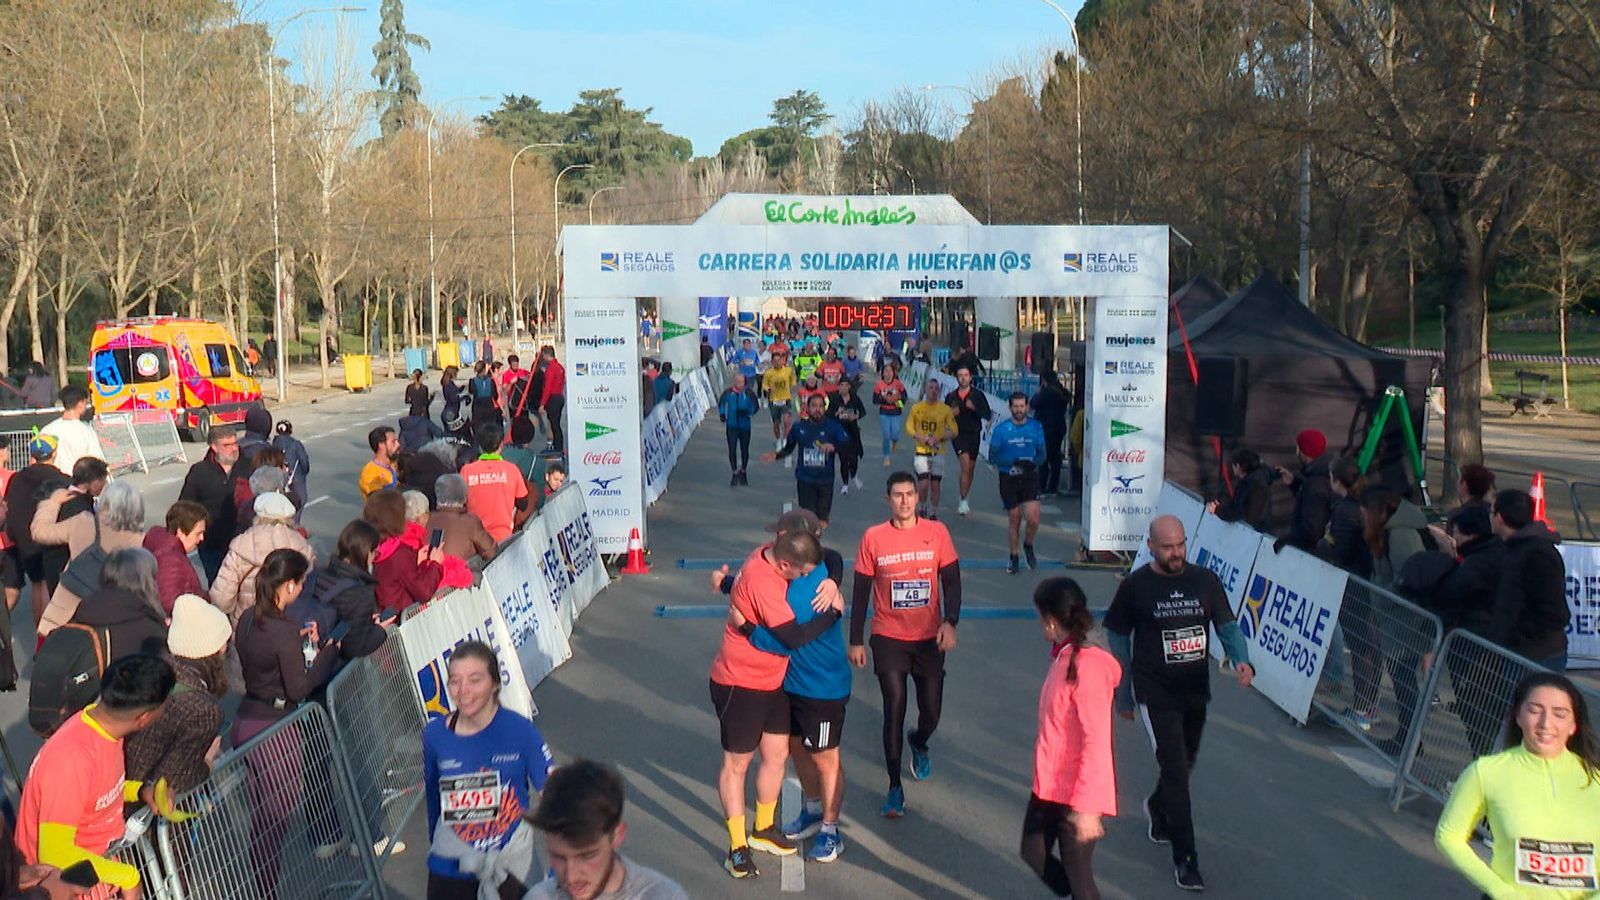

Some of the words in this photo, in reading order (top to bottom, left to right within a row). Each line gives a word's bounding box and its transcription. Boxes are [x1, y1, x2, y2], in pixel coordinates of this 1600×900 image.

[764, 200, 786, 223] El
[788, 201, 839, 224] Corte
[841, 198, 916, 225] Inglés
[623, 252, 674, 263] REALE
[698, 252, 792, 271] CARRERA
[800, 252, 899, 271] SOLIDARIA
[907, 243, 1031, 274] HUÉRFAN@S
[1086, 253, 1138, 263] REALE
[623, 263, 675, 272] SEGUROS
[1086, 264, 1139, 273] SEGUROS
[824, 304, 909, 329] 00:42:37
[591, 361, 626, 370] REALE
[1120, 361, 1154, 369] REALE
[577, 395, 628, 405] PARADORES
[1104, 393, 1155, 403] PARADORES
[921, 420, 937, 432] 60
[480, 472, 507, 481] REALE
[592, 508, 630, 517] MADRID
[1113, 506, 1151, 515] MADRID
[905, 590, 919, 600] 48
[1156, 599, 1200, 610] PARADORES
[1269, 584, 1331, 647] REALE
[1170, 638, 1201, 653] 5044
[1259, 624, 1318, 678] SEGUROS
[449, 788, 493, 810] 5495
[1529, 851, 1584, 873] 5200
